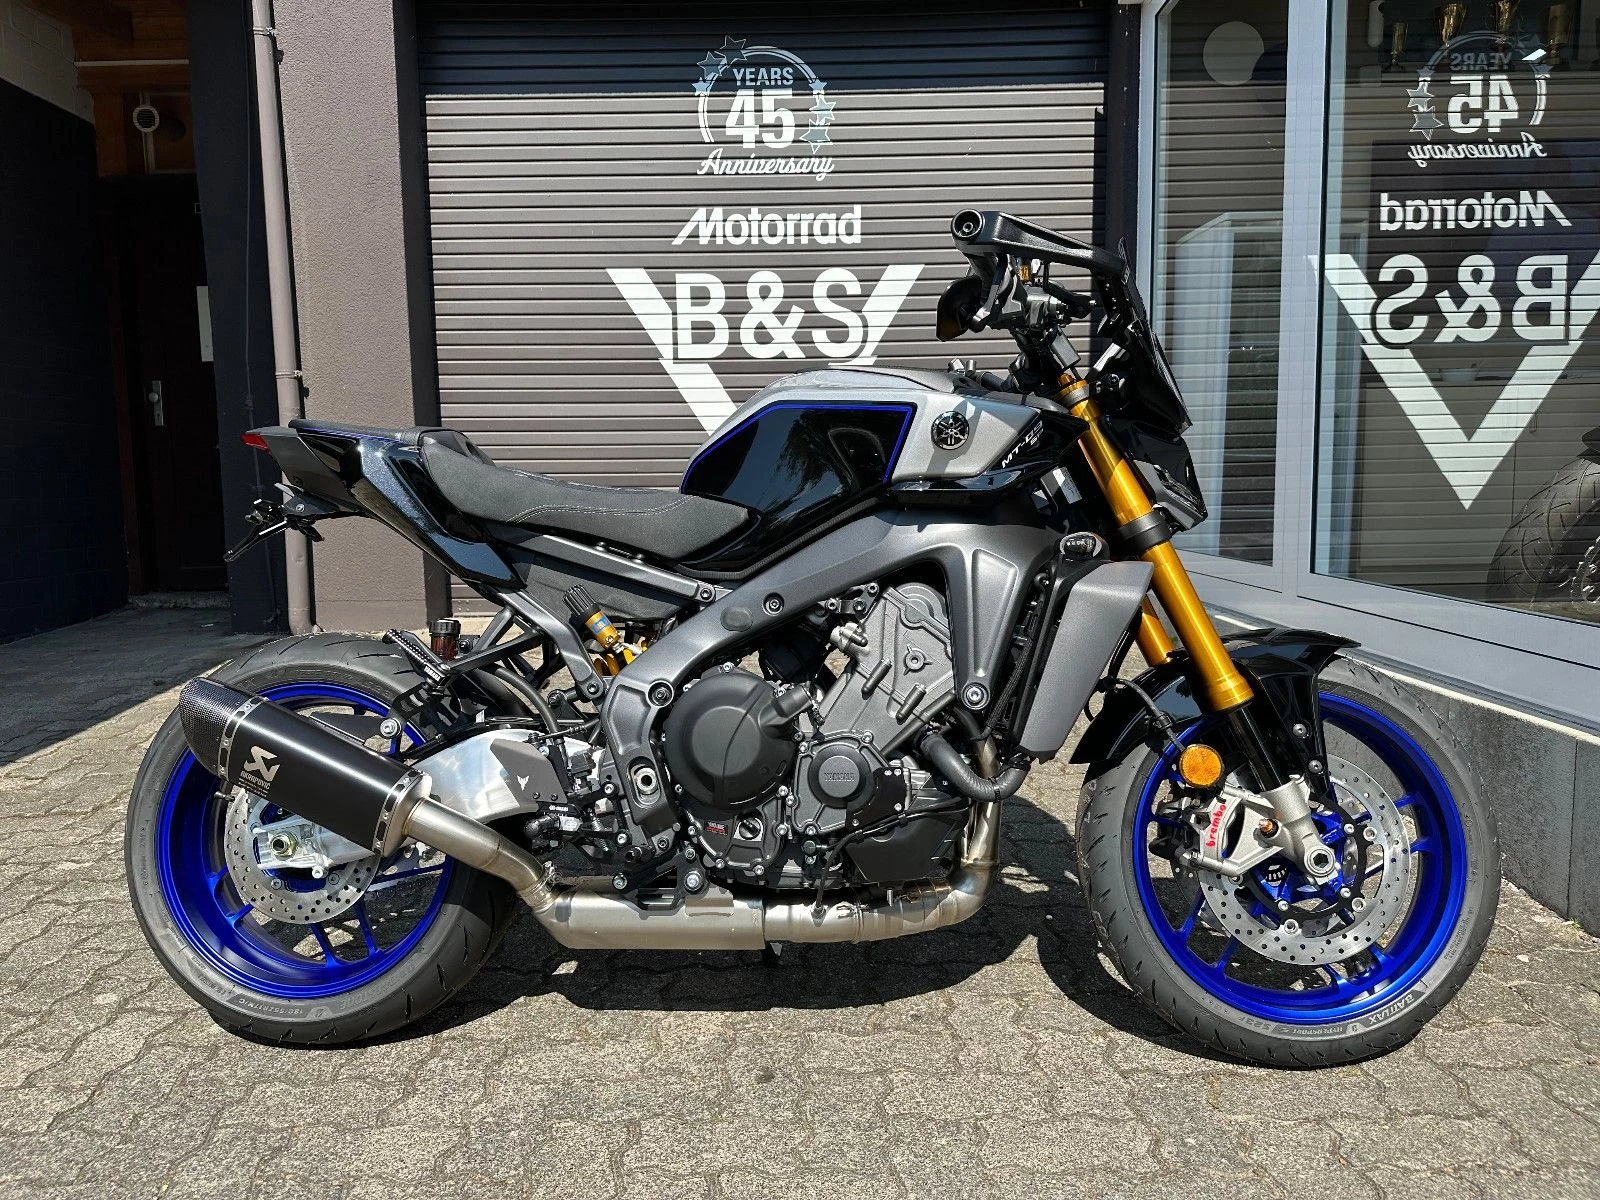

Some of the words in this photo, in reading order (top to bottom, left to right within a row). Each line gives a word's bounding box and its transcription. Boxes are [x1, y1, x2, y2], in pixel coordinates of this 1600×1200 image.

[733, 66, 794, 86] YEARS
[725, 88, 796, 149] 45
[697, 148, 835, 181] Anniversary
[671, 204, 862, 246] Motorrad
[675, 267, 863, 359] B&S
[1205, 804, 1227, 848] brembo
